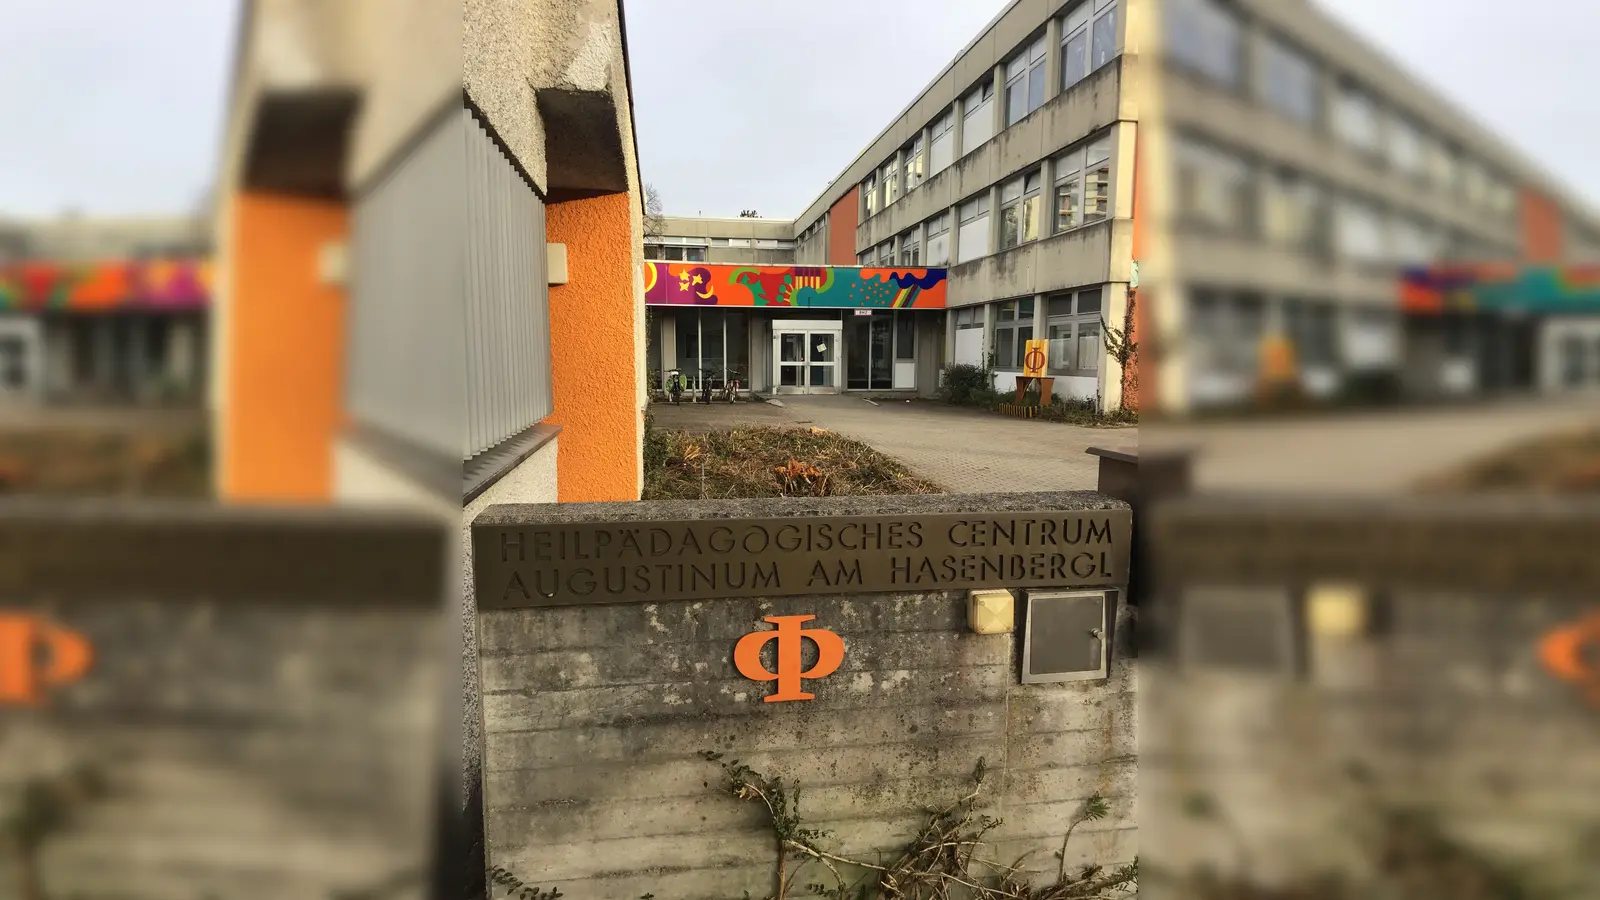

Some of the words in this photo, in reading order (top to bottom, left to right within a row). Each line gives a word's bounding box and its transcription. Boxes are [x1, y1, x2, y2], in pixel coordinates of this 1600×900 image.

[500, 521, 924, 562] HEILPÄDAGOGISCHES
[948, 518, 1113, 548] CENTRUM
[502, 561, 782, 600] AUGUSTINUM
[806, 558, 863, 587] AM
[890, 551, 1112, 585] HASENBERGL
